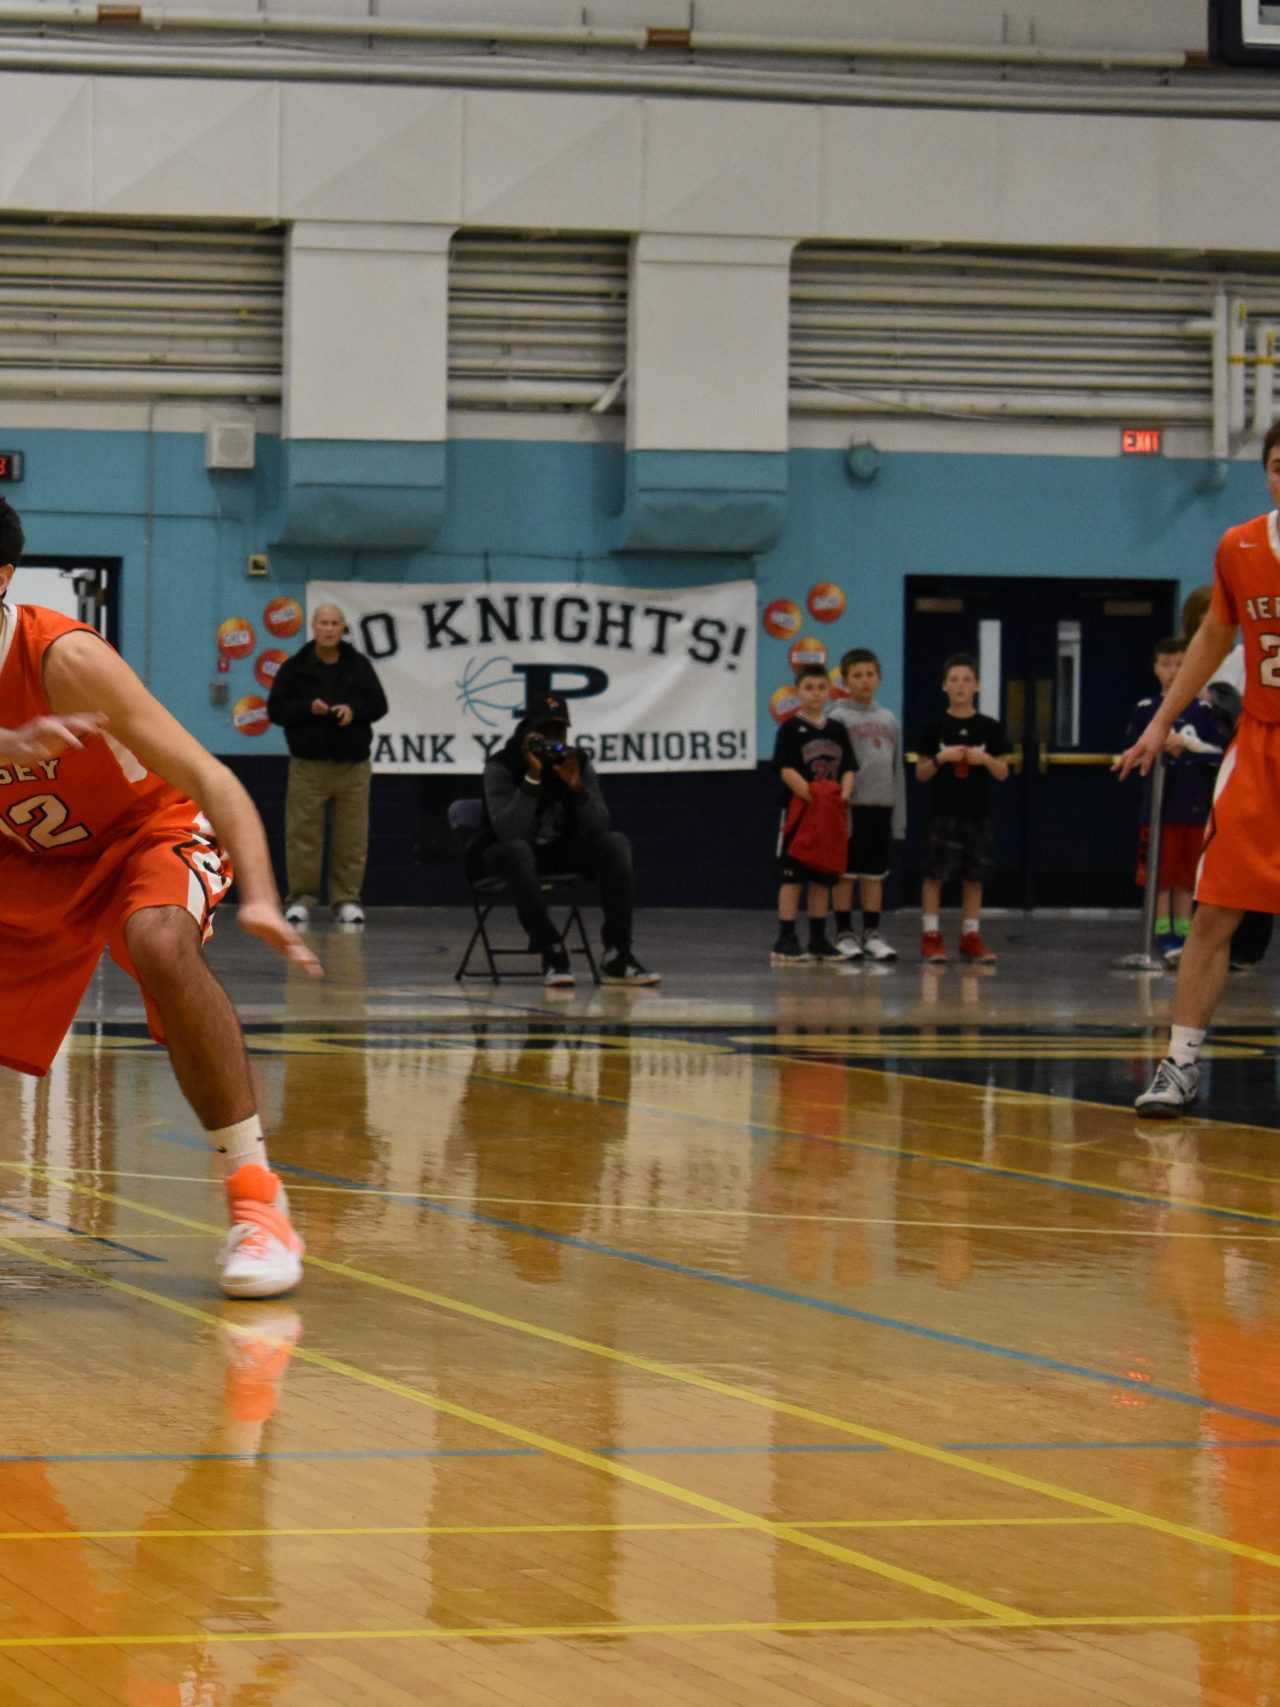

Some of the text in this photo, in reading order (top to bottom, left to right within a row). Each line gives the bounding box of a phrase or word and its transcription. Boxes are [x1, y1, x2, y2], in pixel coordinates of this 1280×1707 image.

[1123, 430, 1160, 452] EXIT
[421, 595, 747, 671] KNIGHTS!
[374, 733, 456, 763] ANK
